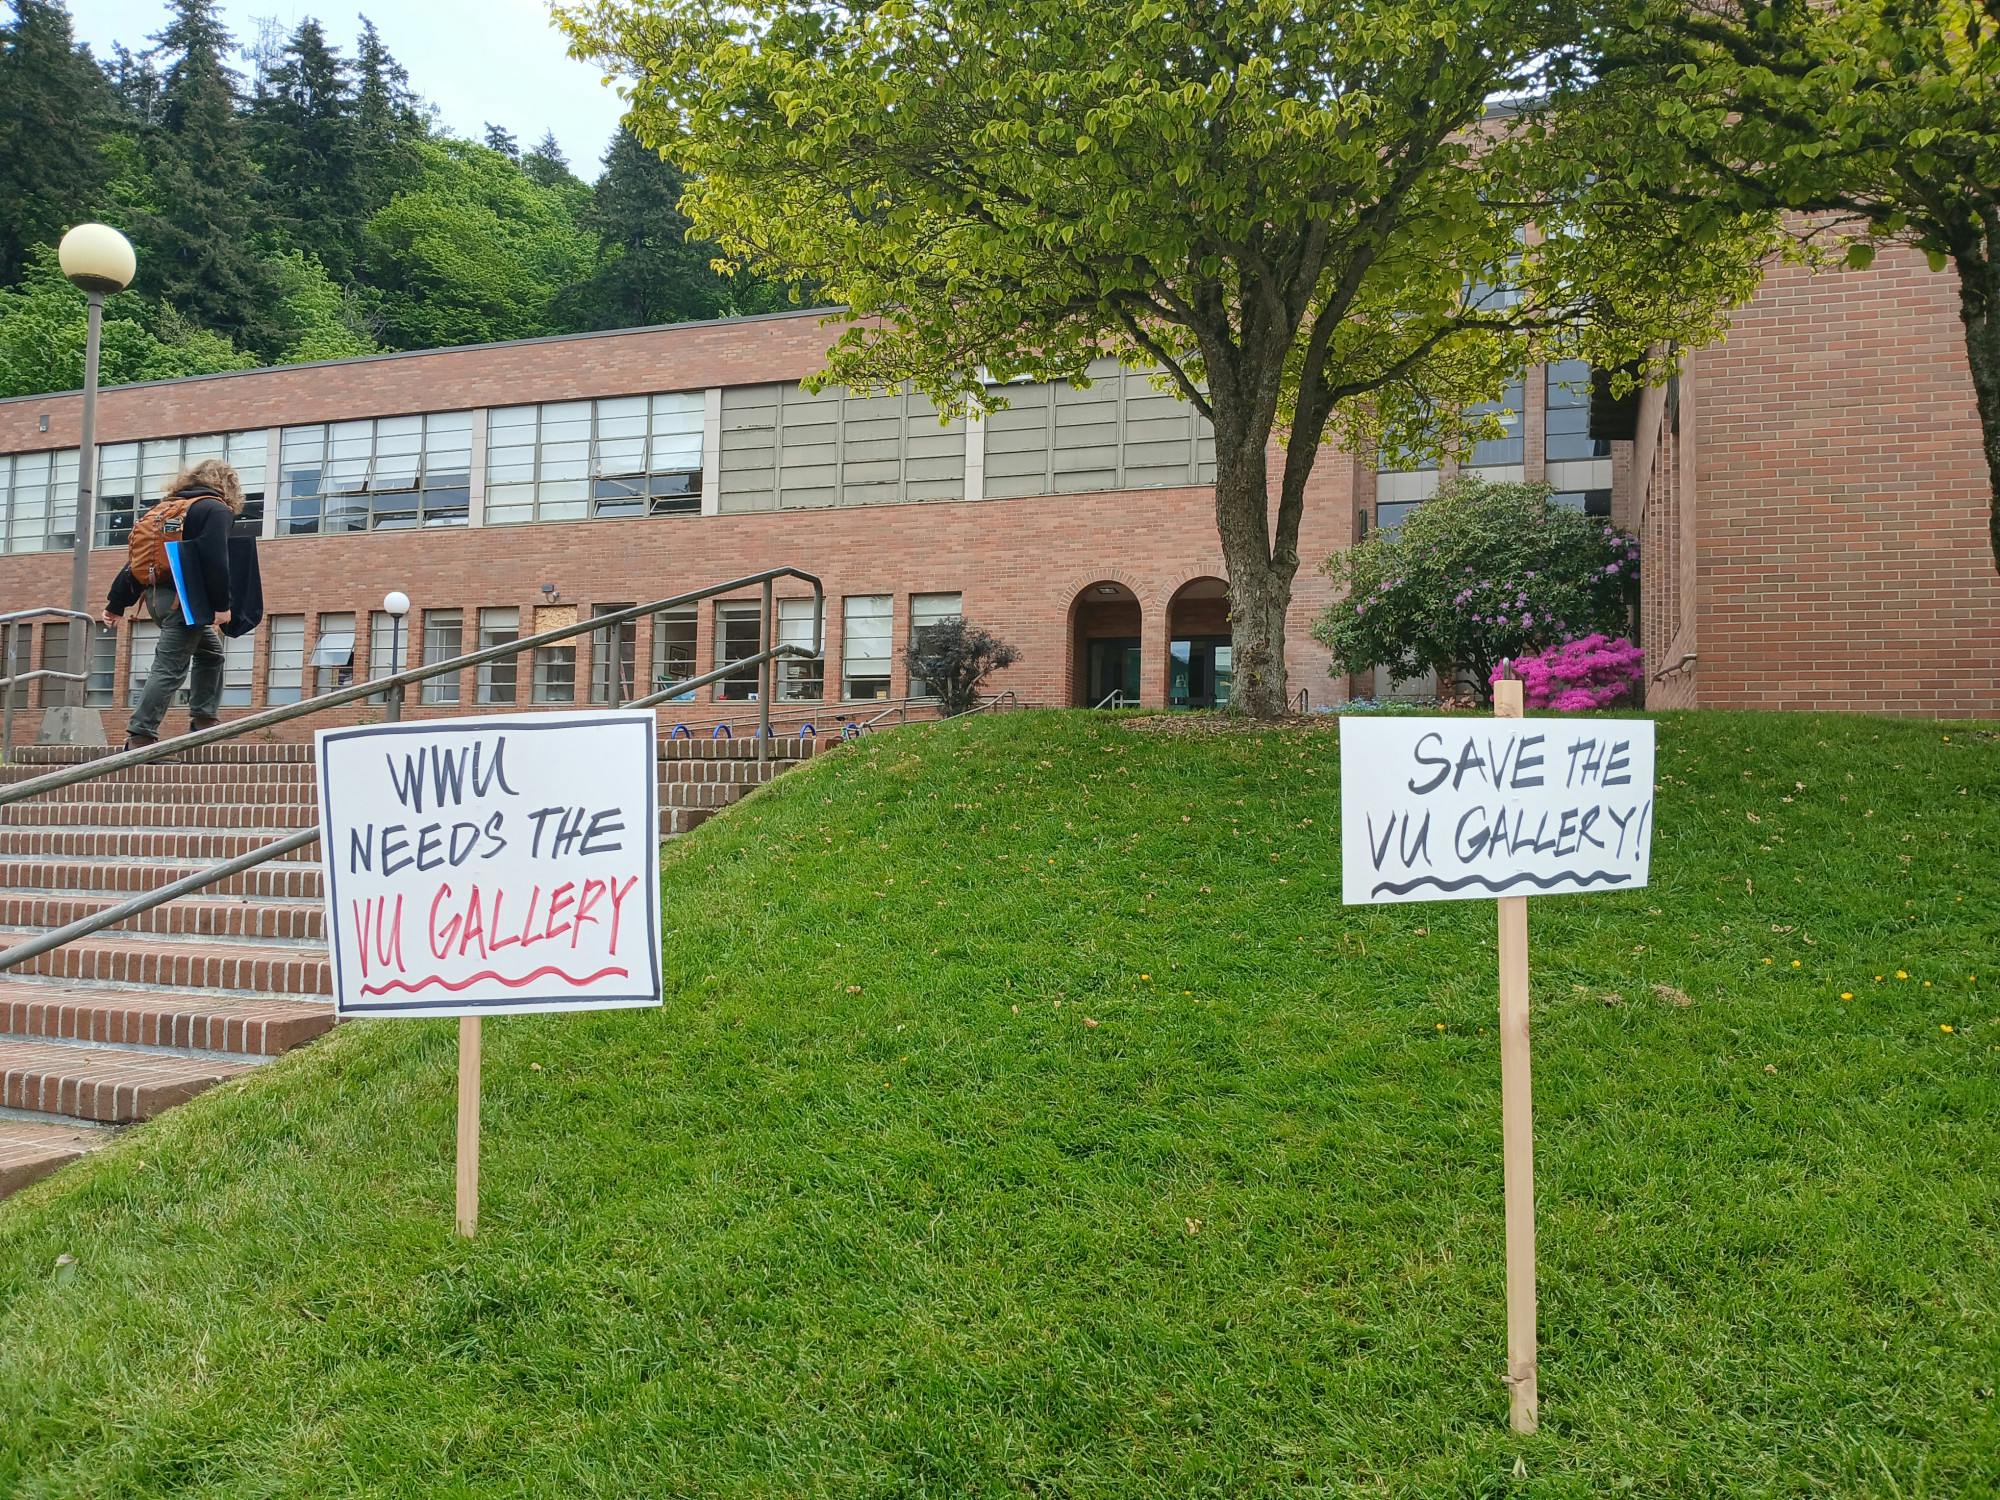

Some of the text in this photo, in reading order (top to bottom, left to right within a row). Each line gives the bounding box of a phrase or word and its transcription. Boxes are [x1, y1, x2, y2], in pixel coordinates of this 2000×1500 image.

[386, 736, 520, 814] WWU
[1408, 732, 1631, 795] SAVE THE
[351, 806, 626, 877] NEEDS THE
[1366, 800, 1650, 872] VU GALLERY!
[353, 875, 639, 978] VU GALLERY
